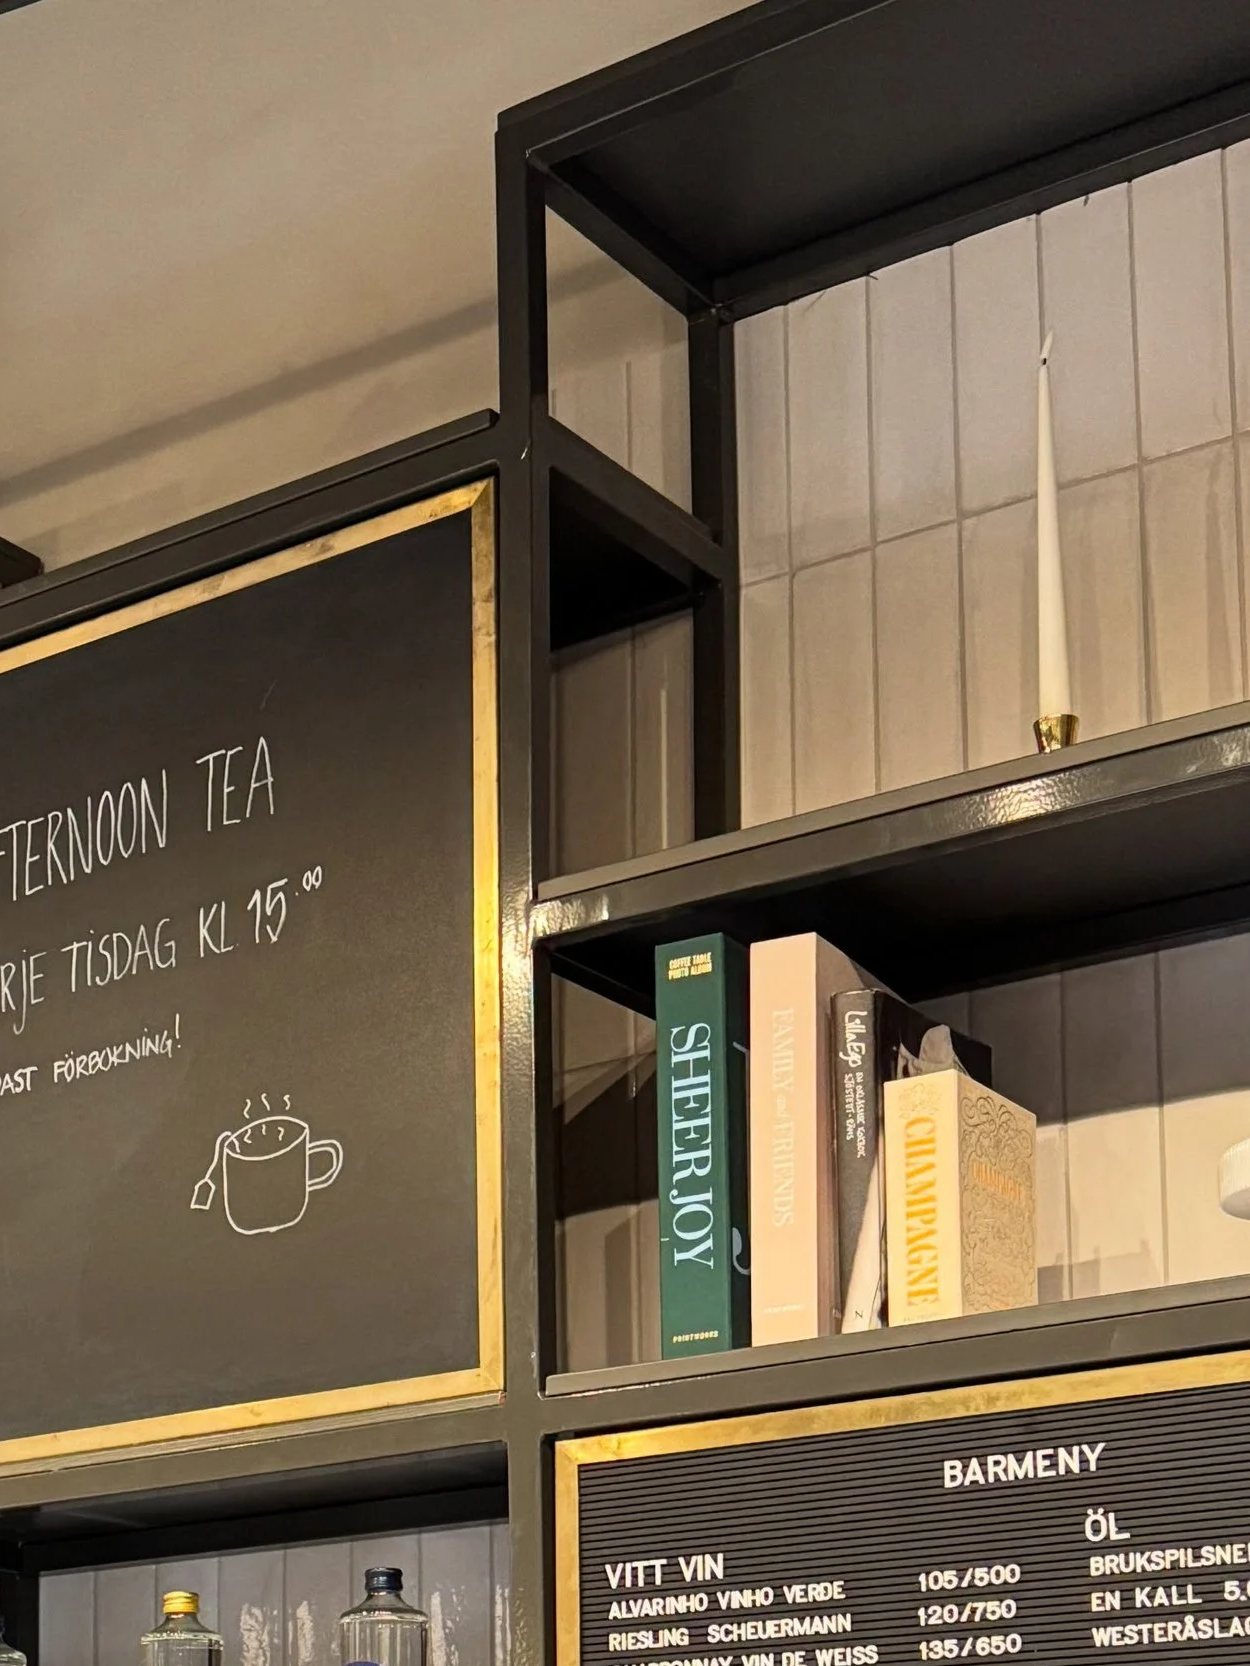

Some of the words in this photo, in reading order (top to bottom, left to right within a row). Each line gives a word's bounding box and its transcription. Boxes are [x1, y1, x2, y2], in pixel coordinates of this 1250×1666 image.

[196, 736, 274, 831] TEA
[199, 901, 235, 958] KL
[773, 1008, 794, 1090] FAMILY
[670, 1022, 712, 1187] SHEER
[773, 1116, 794, 1227] FRIENDS
[669, 1187, 714, 1269] JOY
[903, 1115, 939, 1307] CHAMPAGNE
[943, 1442, 1106, 1488] BARMENY
[1085, 1508, 1131, 1542] ÖL
[605, 1559, 667, 1589] VITT
[679, 1553, 724, 1582] VIN
[609, 1593, 708, 1620] ALVARINHO
[717, 1587, 774, 1610] VINHO
[783, 1581, 846, 1603] VERDE
[919, 1564, 1021, 1592] 105/500
[1091, 1590, 1121, 1612] EN
[1135, 1584, 1202, 1608] KALL
[609, 1628, 689, 1652] RIESLING
[707, 1613, 852, 1644] SCHEUERMANN
[918, 1599, 1017, 1627] 120/750
[919, 1633, 1022, 1660] 135/650
